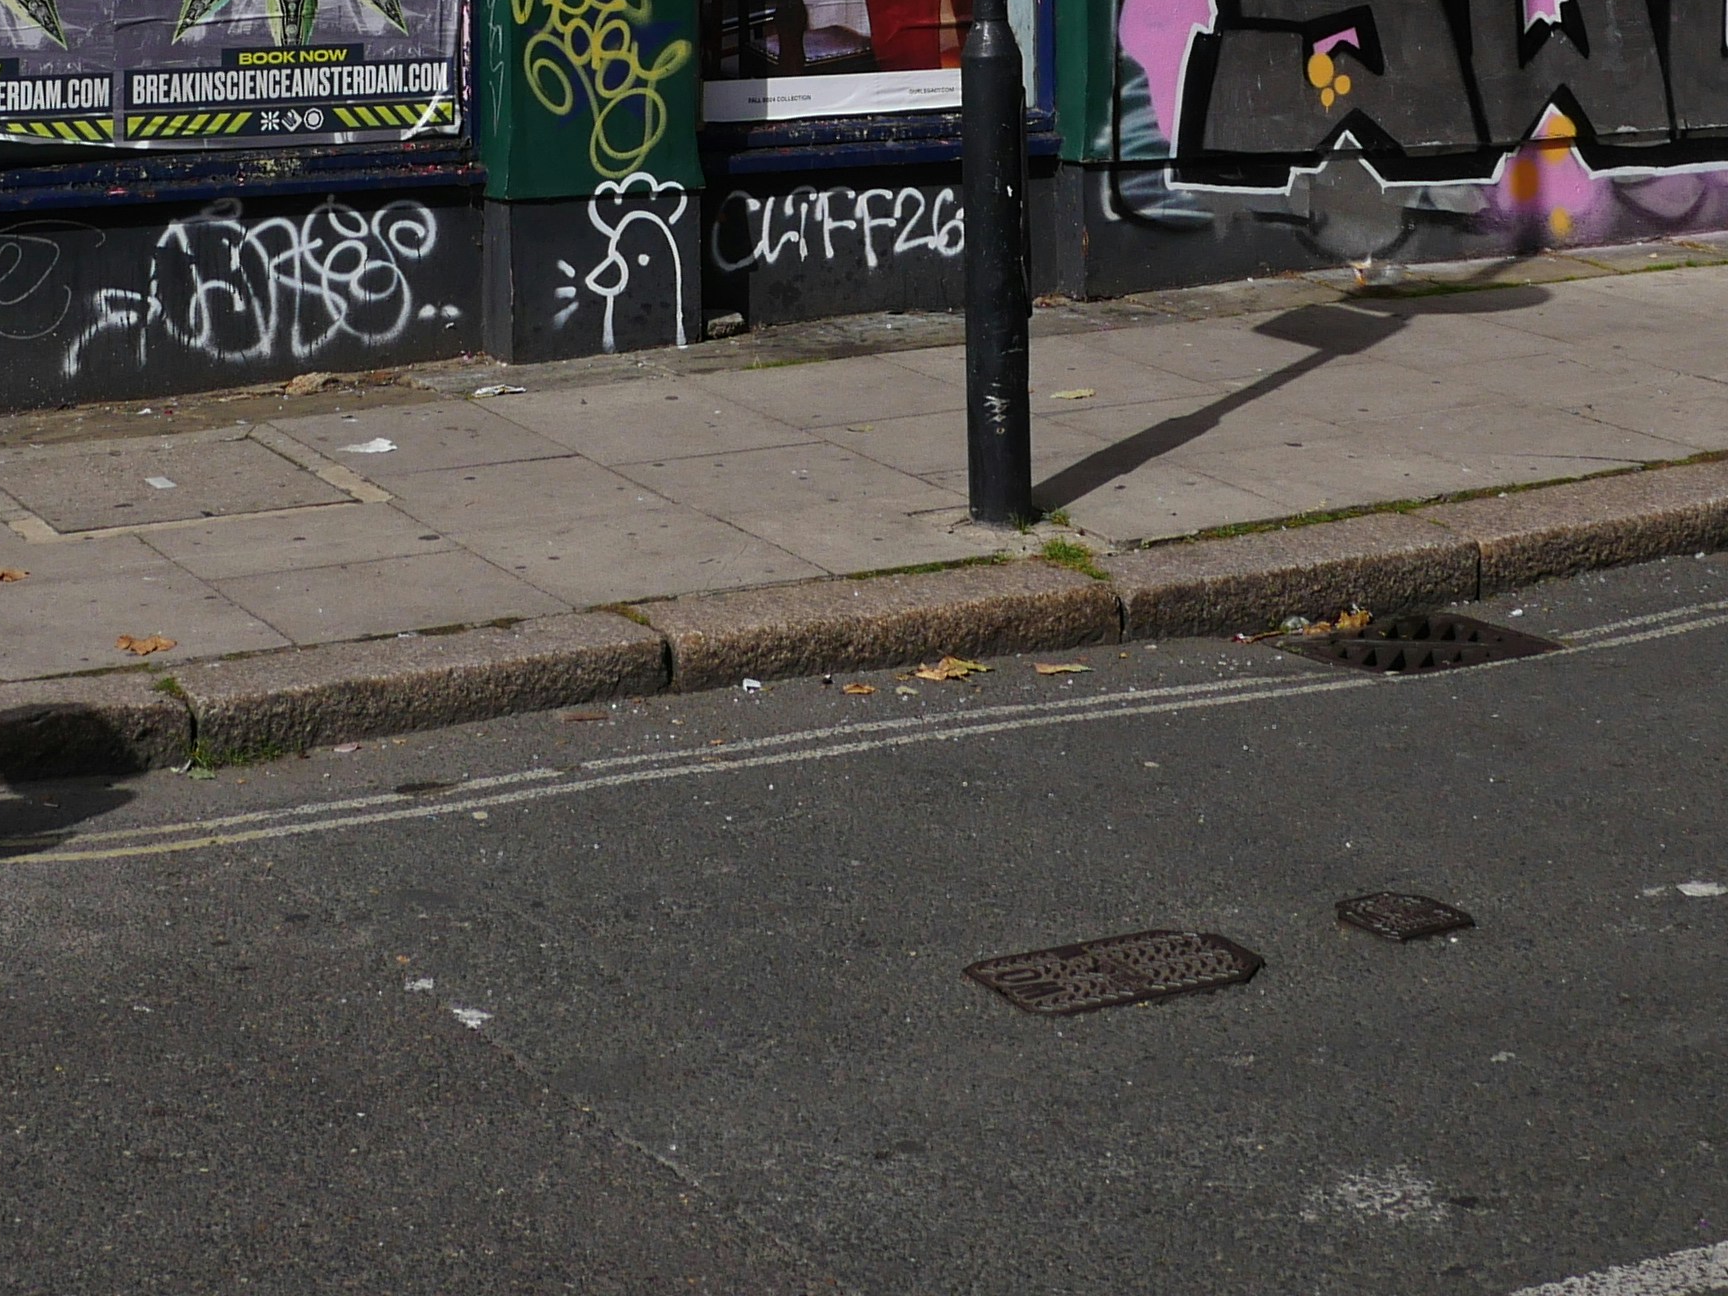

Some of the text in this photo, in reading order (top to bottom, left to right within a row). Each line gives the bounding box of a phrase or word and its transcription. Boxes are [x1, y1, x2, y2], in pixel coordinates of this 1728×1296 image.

[238, 49, 347, 65] BOOK NOW
[132, 62, 448, 105] BREAKINSCIENCEAMSTERDAM.COM
[776, 94, 812, 103] COLLECTION
